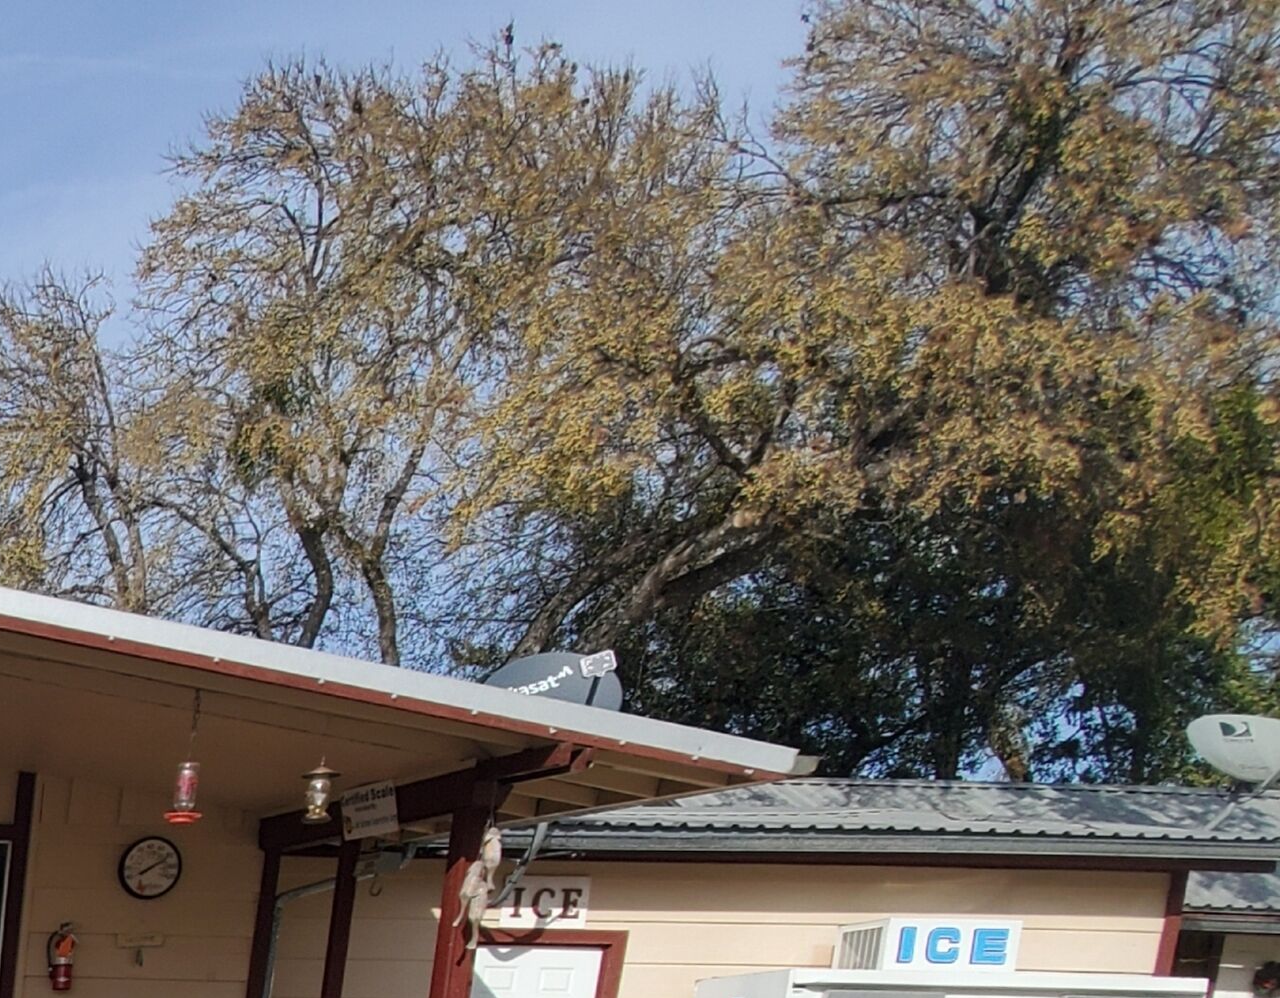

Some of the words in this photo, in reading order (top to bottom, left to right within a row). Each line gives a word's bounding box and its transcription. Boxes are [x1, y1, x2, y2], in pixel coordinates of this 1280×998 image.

[506, 674, 562, 696] asat
[509, 885, 583, 919] ICE
[895, 926, 1010, 965] ICE
